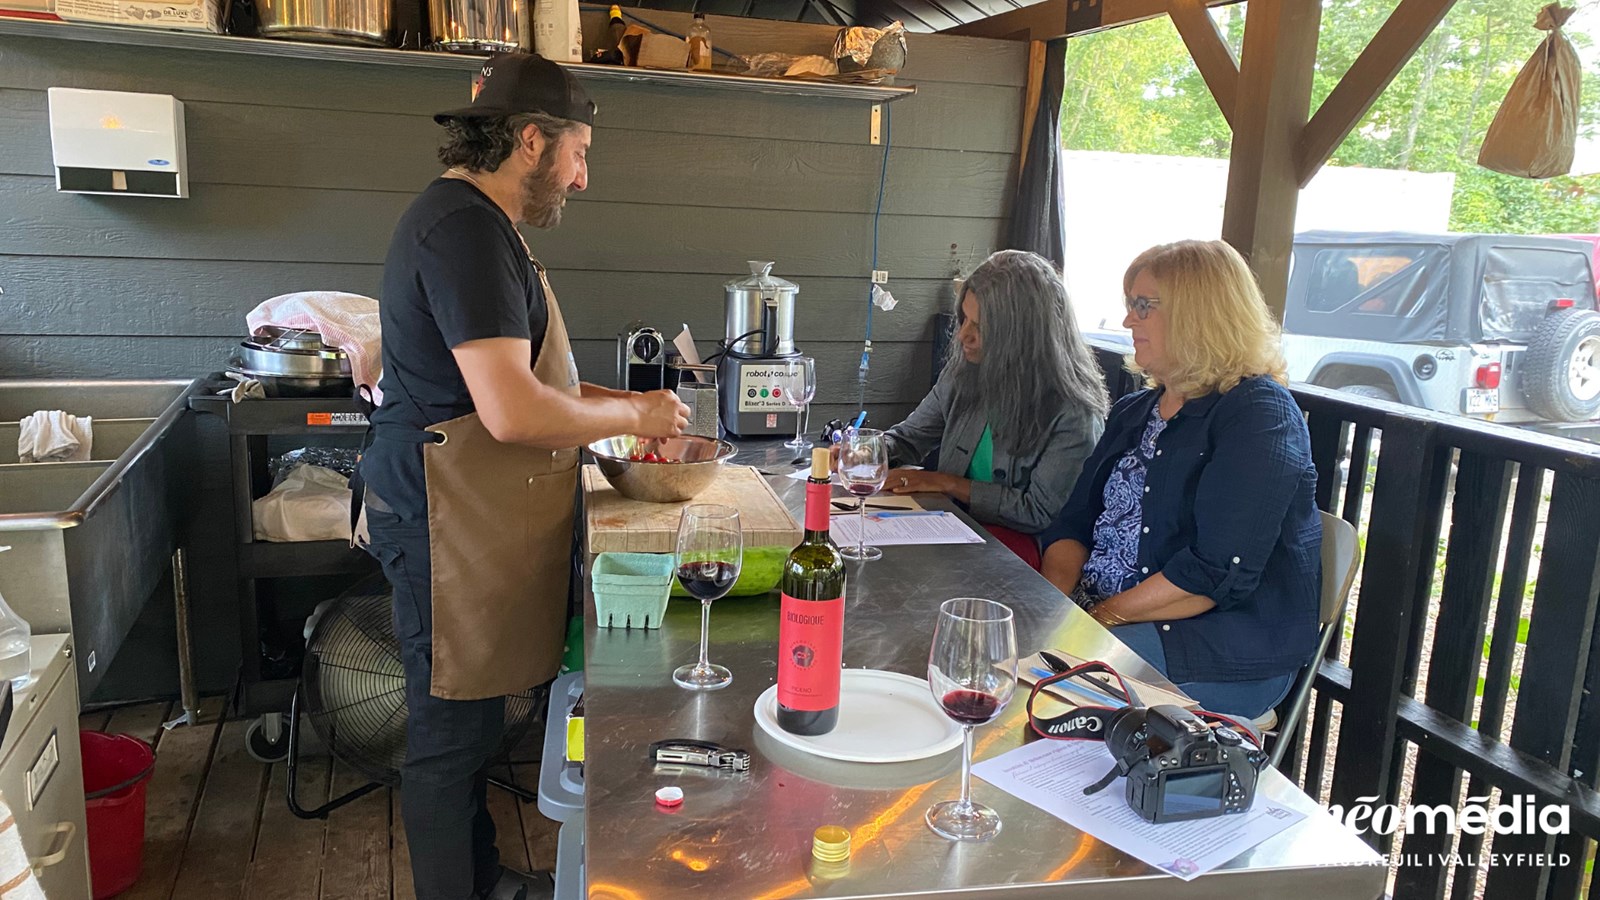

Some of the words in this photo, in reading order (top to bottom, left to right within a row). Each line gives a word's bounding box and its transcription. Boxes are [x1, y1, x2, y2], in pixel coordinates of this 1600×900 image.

[481, 67, 493, 76] NS
[787, 611, 824, 625] BIOLOGIQUE
[1048, 716, 1103, 734] Canon
